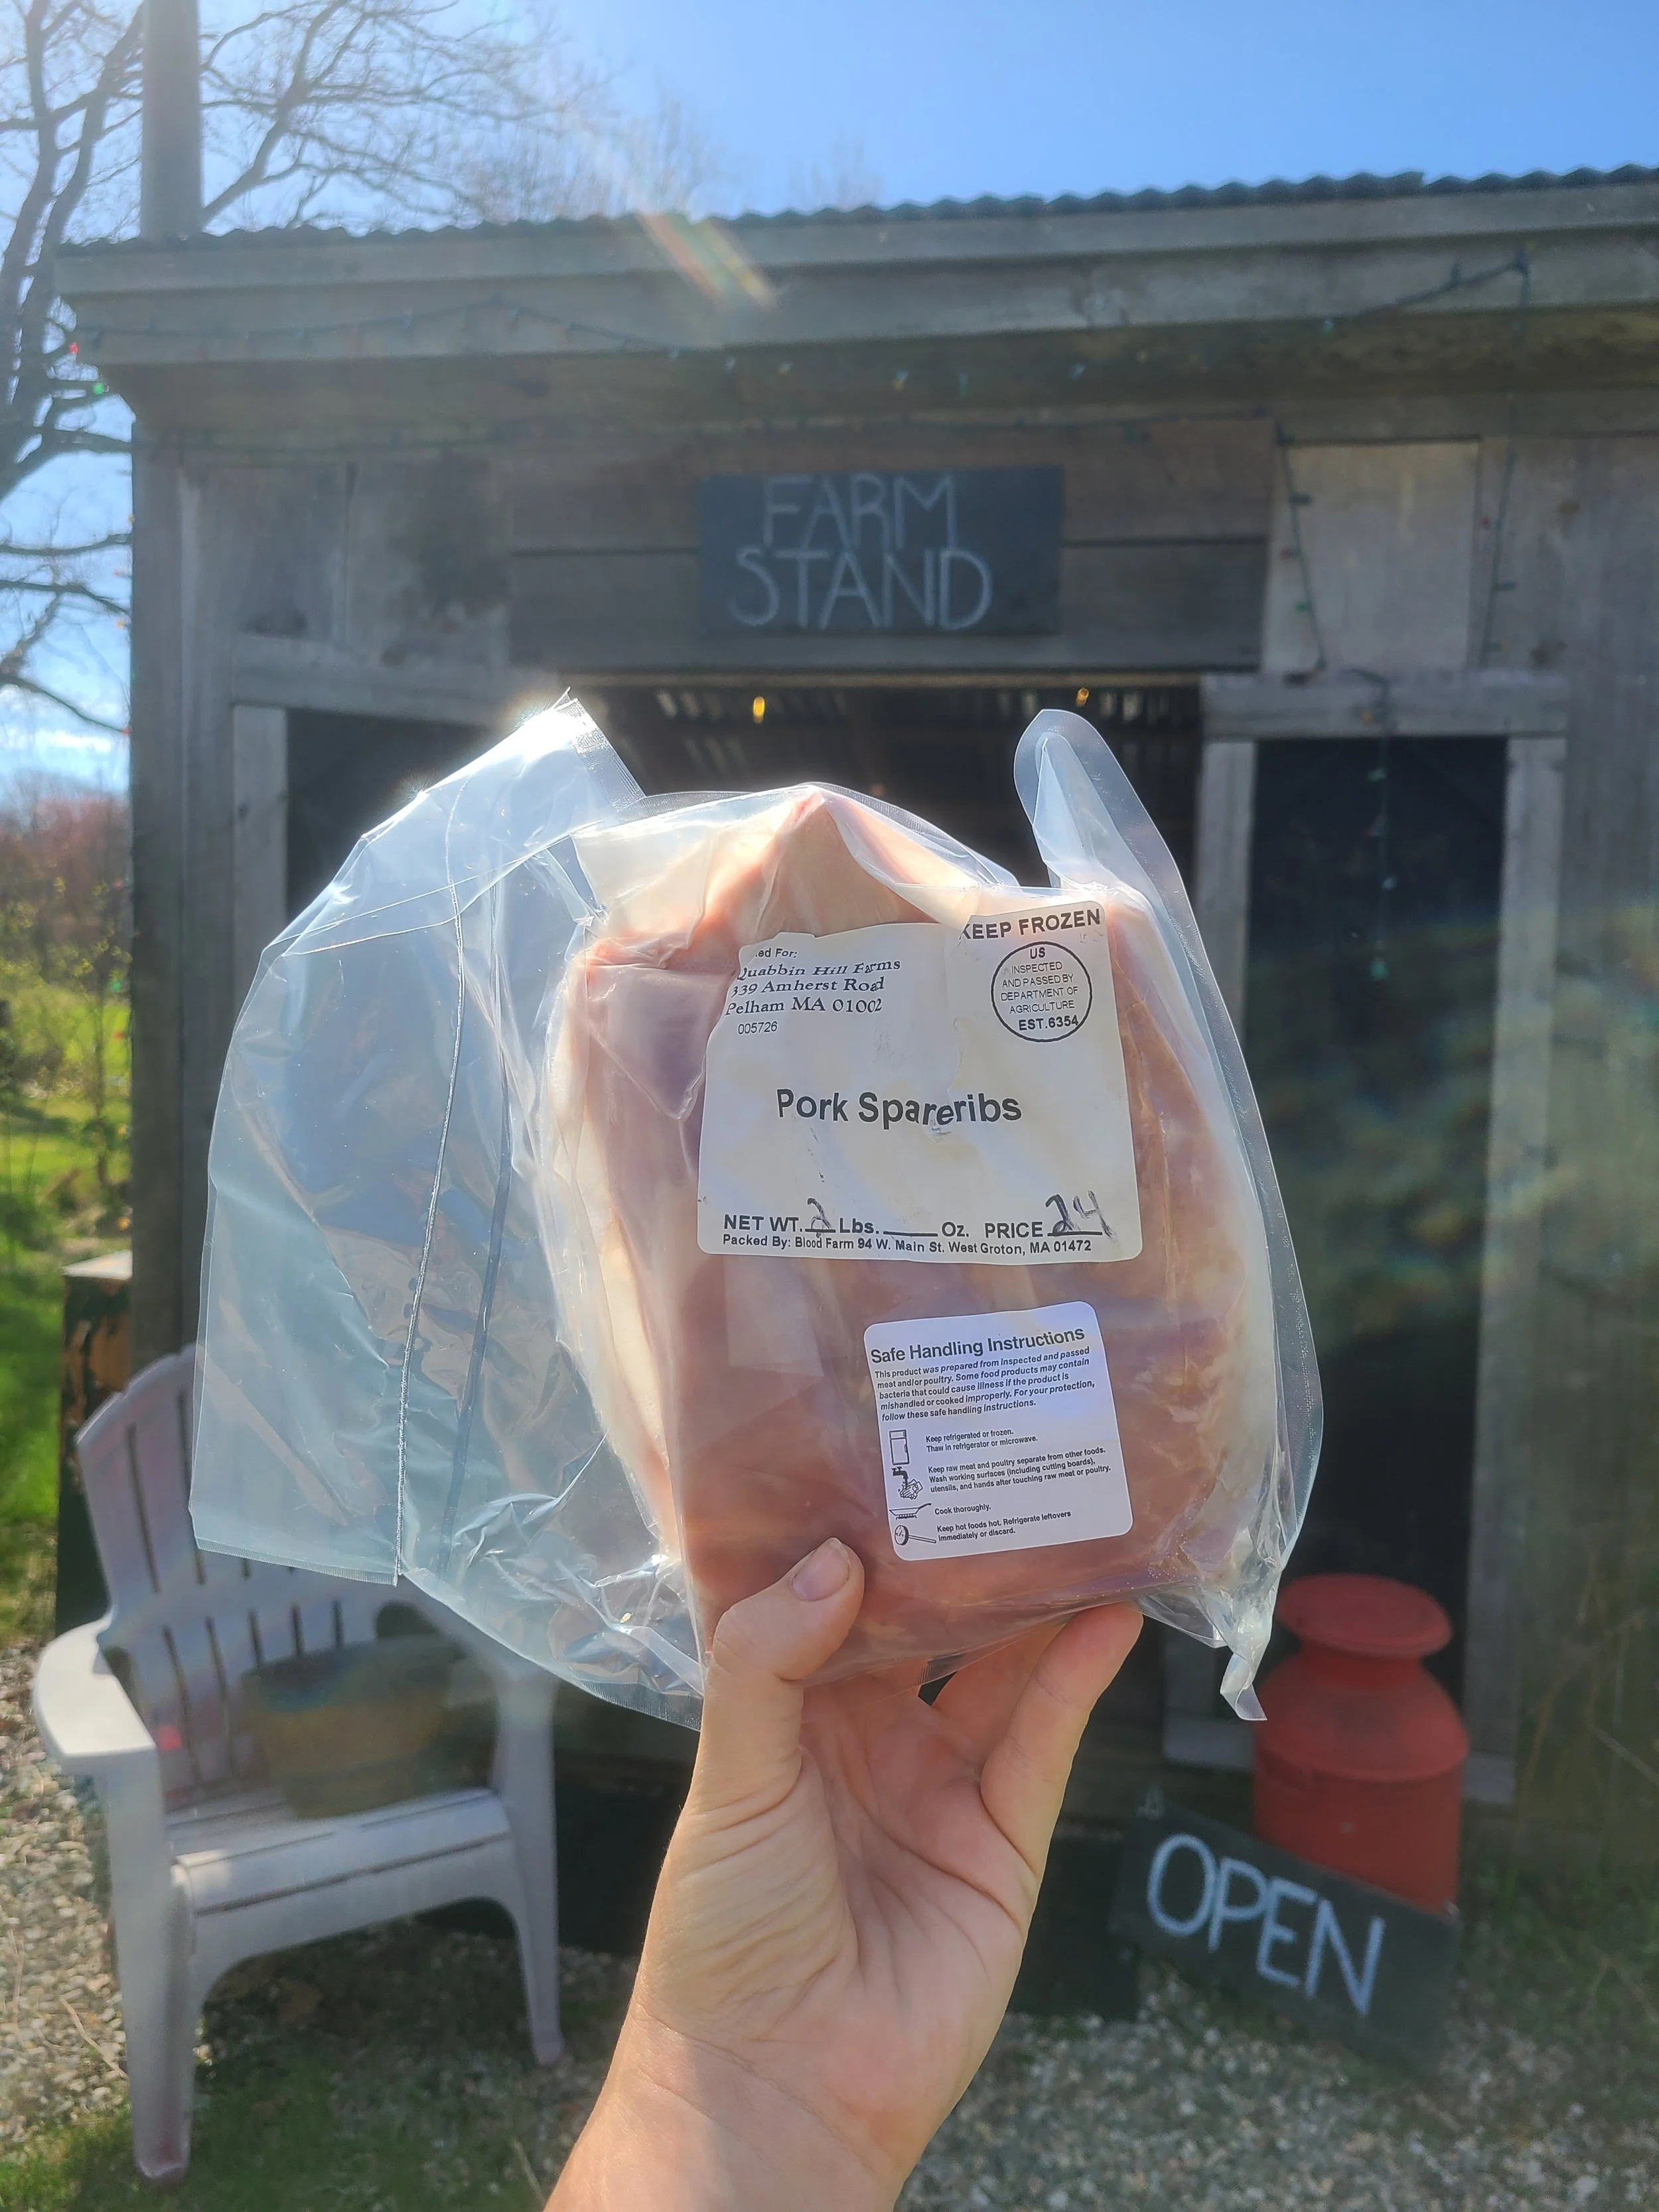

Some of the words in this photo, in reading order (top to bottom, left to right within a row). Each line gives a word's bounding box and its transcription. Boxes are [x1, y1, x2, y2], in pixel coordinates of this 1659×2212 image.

[763, 473, 957, 549] FARM
[729, 545, 992, 630] STAND
[959, 922, 1011, 940] KEEP
[1019, 909, 1100, 935] FROZEN
[755, 948, 771, 958] ed
[776, 948, 797, 958] For:
[1030, 947, 1045, 958] US
[812, 965, 848, 976] Hill
[853, 960, 901, 974] Farms
[1011, 962, 1062, 974] INSPECTED
[731, 984, 758, 998] 339
[760, 980, 837, 993] Amherst
[843, 977, 884, 992] Road
[1002, 980, 1021, 988] AND
[1023, 976, 1060, 987] PASSED
[1062, 974, 1073, 982] BY
[1001, 988, 1063, 1001] DEPARTMENT
[725, 1001, 784, 1015] Pelham
[791, 997, 826, 1011] MA
[832, 998, 883, 1013] 01002
[1009, 1000, 1074, 1014] AGRICULTURE
[738, 1021, 777, 1034] 005726
[1019, 1015, 1078, 1031] EST.6354
[776, 1088, 849, 1122] Pork
[858, 1092, 1022, 1130] Spareribs
[724, 1215, 763, 1230] NET
[770, 1217, 802, 1232] WT.
[1045, 1191, 1114, 1240] 24
[840, 1218, 879, 1234] Lbs.
[942, 1222, 969, 1237] Oz.
[985, 1222, 1043, 1238] PRICE
[723, 1234, 767, 1246] Packed
[772, 1236, 791, 1250] By:
[796, 1237, 822, 1248] Blood
[826, 1238, 853, 1249] Farm
[857, 1238, 872, 1248] 94
[876, 1239, 891, 1250] W.
[896, 1240, 924, 1252] Main
[929, 1242, 945, 1252] St.
[948, 1242, 977, 1253] West
[981, 1242, 1025, 1256] Groton,
[1030, 1242, 1050, 1253] MA
[1054, 1240, 1091, 1252] 01472
[871, 1348, 905, 1363] Safe
[909, 1341, 983, 1359] Handling
[987, 1329, 1085, 1352] Instructions
[893, 1367, 921, 1378] product
[941, 1361, 978, 1372] prepared
[1001, 1355, 1041, 1366] inspected
[1044, 1352, 1058, 1361] and
[1060, 1347, 1090, 1358] passed
[924, 1376, 954, 1386] poultry.
[956, 1372, 979, 1381] Some
[1001, 1366, 1038, 1377] products
[1059, 1359, 1090, 1369] contain
[928, 1386, 950, 1395] could
[951, 1384, 975, 1393] cause
[977, 1380, 1003, 1390] illness
[1029, 1374, 1060, 1386] product
[881, 1400, 924, 1410] mishandled
[936, 1396, 964, 1405] cooked
[966, 1391, 1011, 1403] improperly.
[1029, 1387, 1048, 1396] your
[1050, 1380, 1095, 1394] protection,
[948, 1406, 982, 1416] handling
[983, 1400, 1036, 1412] instructions.
[944, 1431, 981, 1441] refrigerated
[953, 1441, 989, 1450] refrigerator
[1000, 1436, 1038, 1445] microwave.
[991, 1459, 1015, 1469] poultry
[1017, 1455, 1046, 1465] separate
[1007, 1465, 1041, 1476] (including
[1013, 1475, 1043, 1484] touching
[1086, 1465, 1111, 1475] poultry.
[954, 1503, 991, 1513] thoroughly.
[968, 1521, 987, 1530] foods
[1003, 1515, 1040, 1525] Refrigerate
[1042, 1511, 1071, 1520] leftovers
[938, 1532, 978, 1542] immediately
[1147, 1832, 1386, 2016] OPEN
